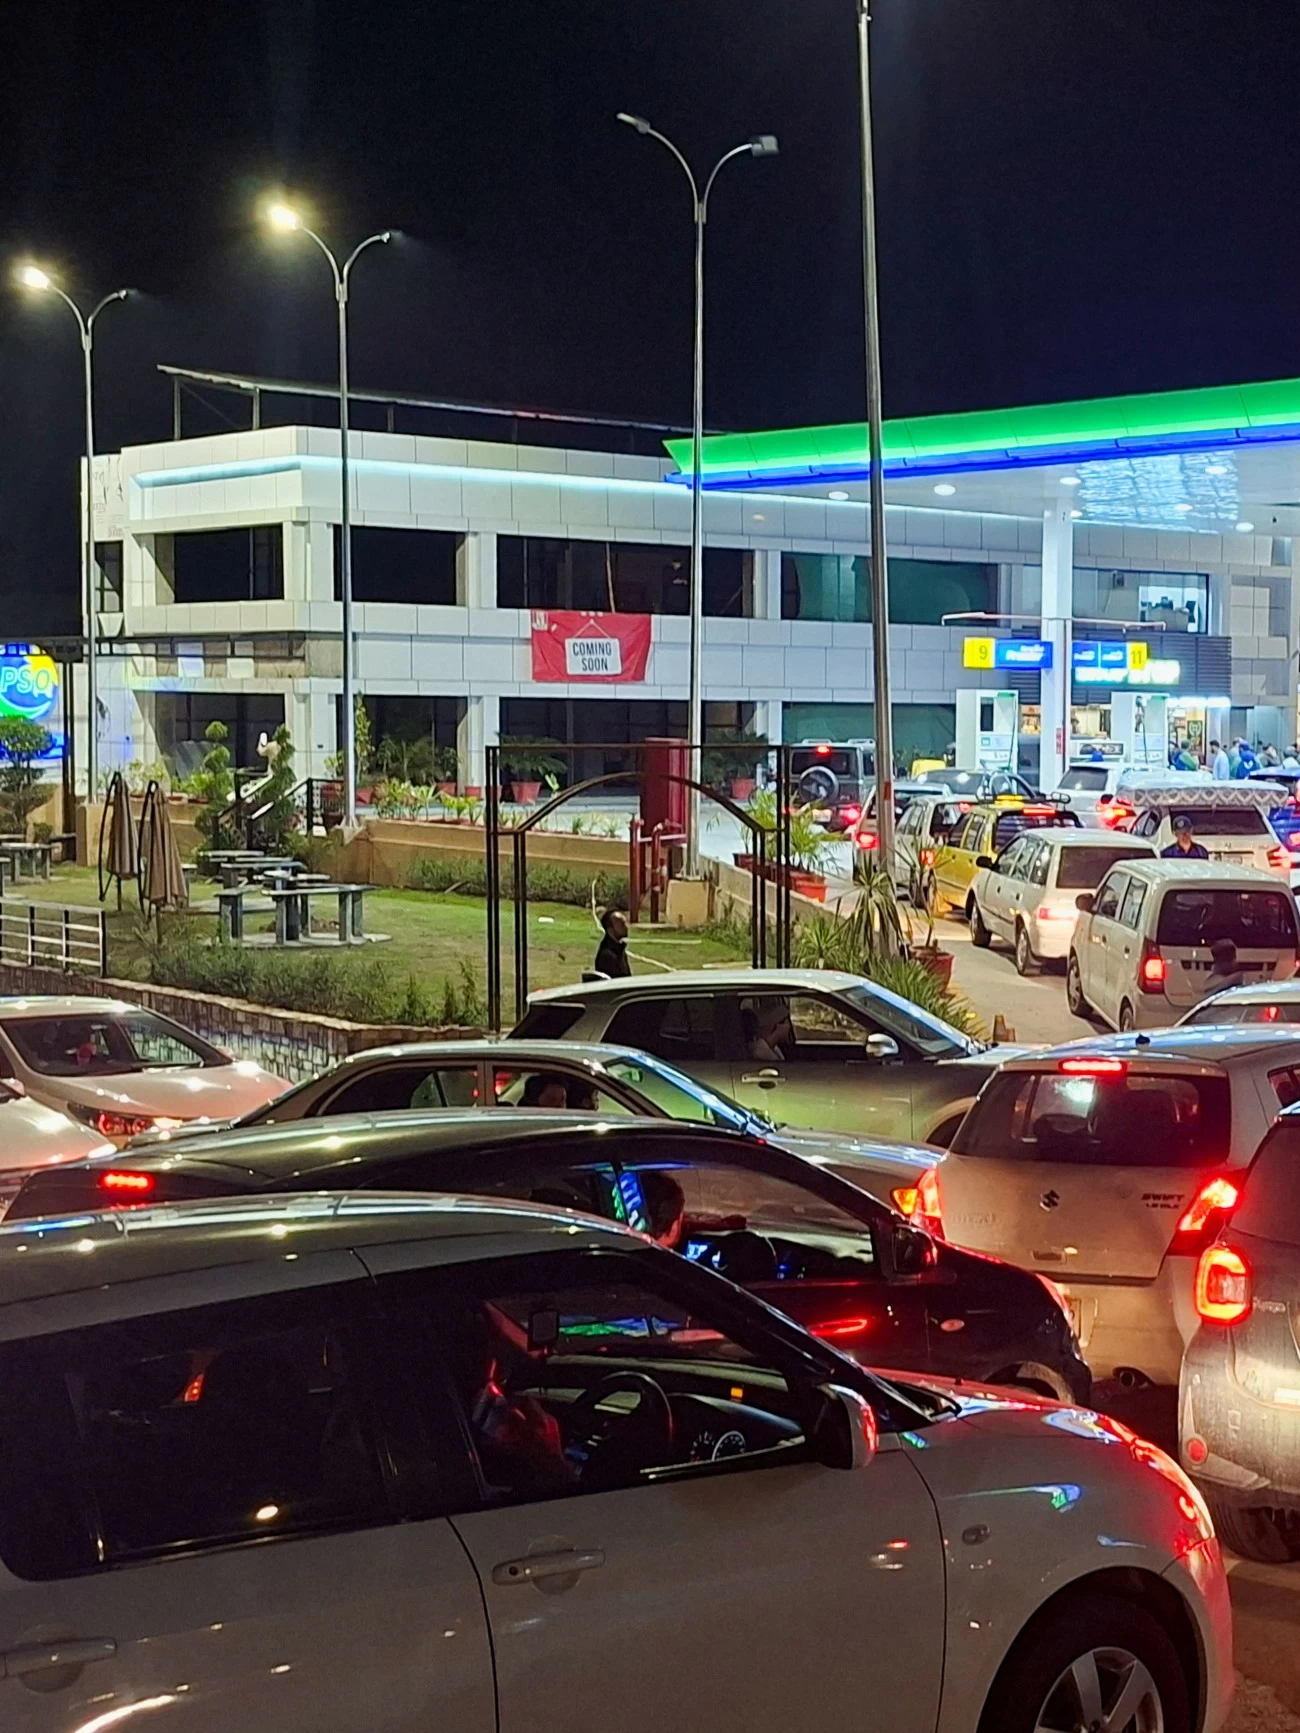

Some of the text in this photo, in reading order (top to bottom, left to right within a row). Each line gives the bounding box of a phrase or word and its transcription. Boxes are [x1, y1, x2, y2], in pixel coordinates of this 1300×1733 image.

[572, 642, 612, 656] COMING
[978, 645, 988, 660] 9
[1131, 650, 1142, 664] 11
[581, 658, 609, 671] SOON
[0, 667, 50, 691] PSO
